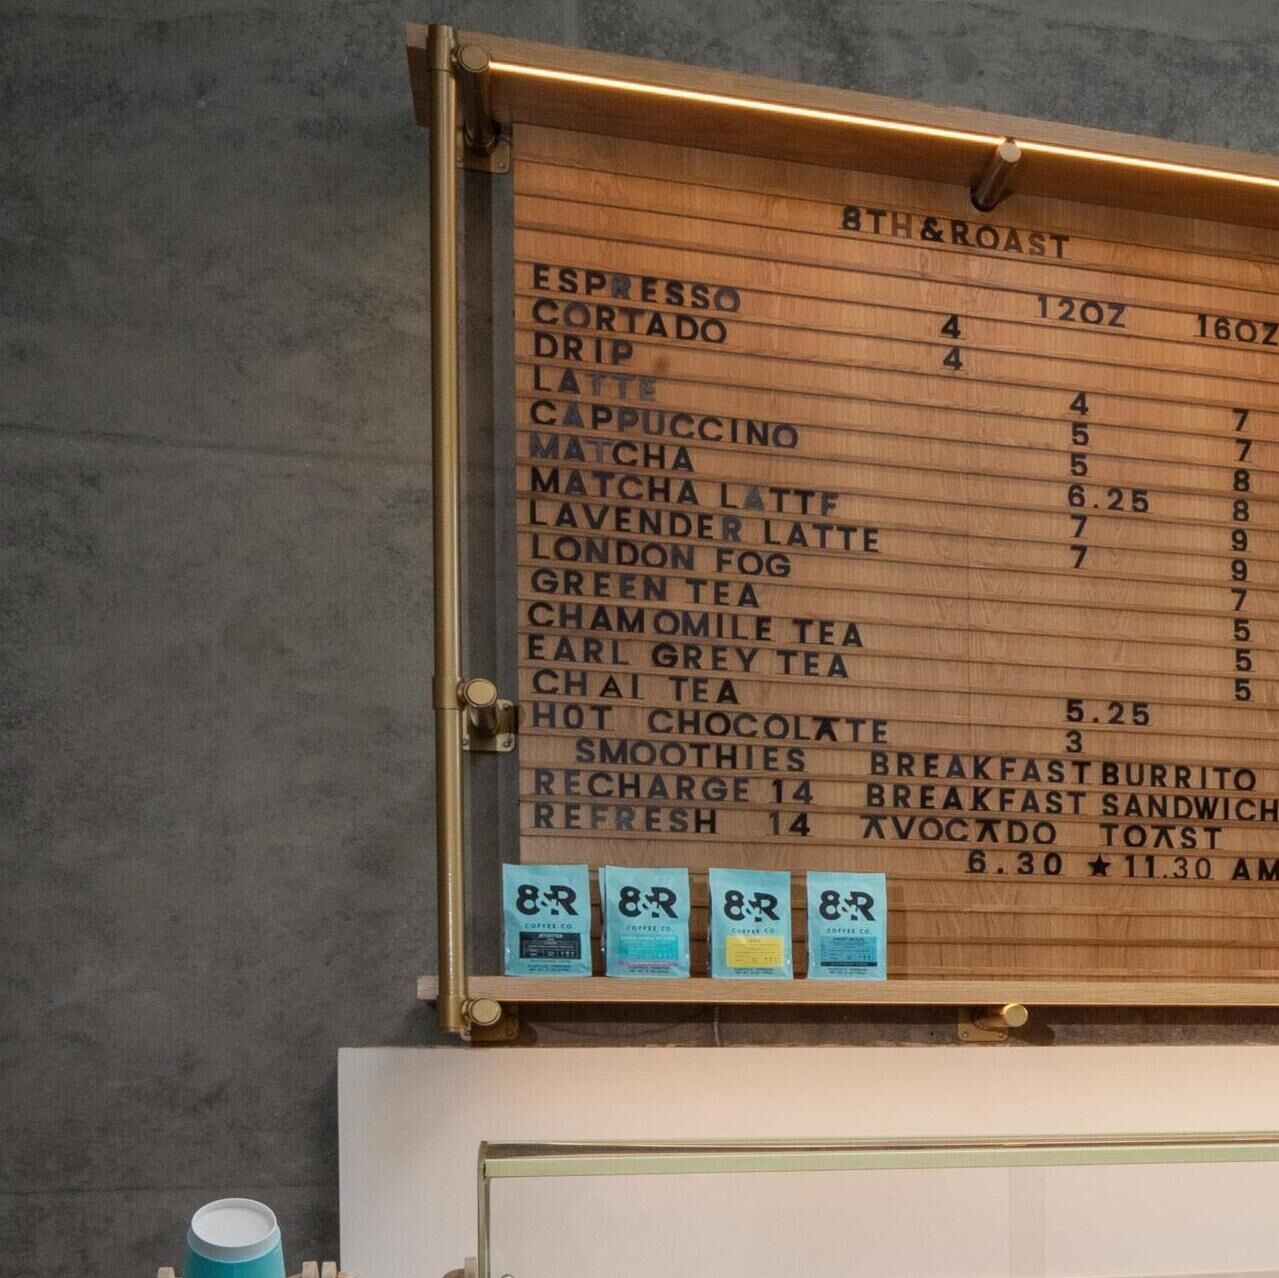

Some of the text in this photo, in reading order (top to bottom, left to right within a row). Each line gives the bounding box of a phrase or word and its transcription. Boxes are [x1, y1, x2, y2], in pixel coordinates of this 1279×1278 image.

[532, 263, 961, 339] ESPRESSO 4
[1038, 295, 1279, 346] 12OZ 16OZ
[532, 297, 963, 371] CORTADO 4
[534, 332, 1250, 432] DRIP 4 7
[533, 366, 1253, 462] LATTE 5 7
[529, 399, 1250, 492] CAPPUCCINO 5 8
[529, 430, 1250, 522] MATCHA 6.25 8
[529, 466, 699, 505] MATCHA
[1071, 515, 1088, 538] 7
[1231, 529, 1248, 552] 9
[529, 500, 1248, 582] LAVENDER LATTE 7 9
[531, 534, 1247, 611] LONDON FOG 7
[531, 568, 1250, 641] GREEN TEA 5
[527, 601, 1252, 671] CHAMOMILE TEA 5
[527, 633, 1251, 701] EARL GREY TEA 5
[531, 668, 1150, 726] CHAI TEA 5.25
[531, 703, 1083, 753] HOT CHOCOLATE 3
[575, 738, 806, 771] SMOOTHIES
[534, 768, 813, 804] RECHARGE 14
[870, 750, 1091, 785] BREAKFAST
[1102, 761, 1257, 792] BURRITO
[534, 802, 811, 836] REFRESH 14
[866, 782, 1086, 815] BREAKFAST
[1101, 793, 1279, 823] SANDWICH
[861, 814, 1056, 844] AVOCADO
[1100, 823, 1223, 850] TOAST
[967, 852, 1063, 876] 6.30
[1125, 855, 1212, 880] 11.30
[516, 884, 579, 916] 8&R
[618, 886, 678, 918] 8&R
[724, 890, 780, 922] 8&R
[819, 890, 876, 922] 8&R
